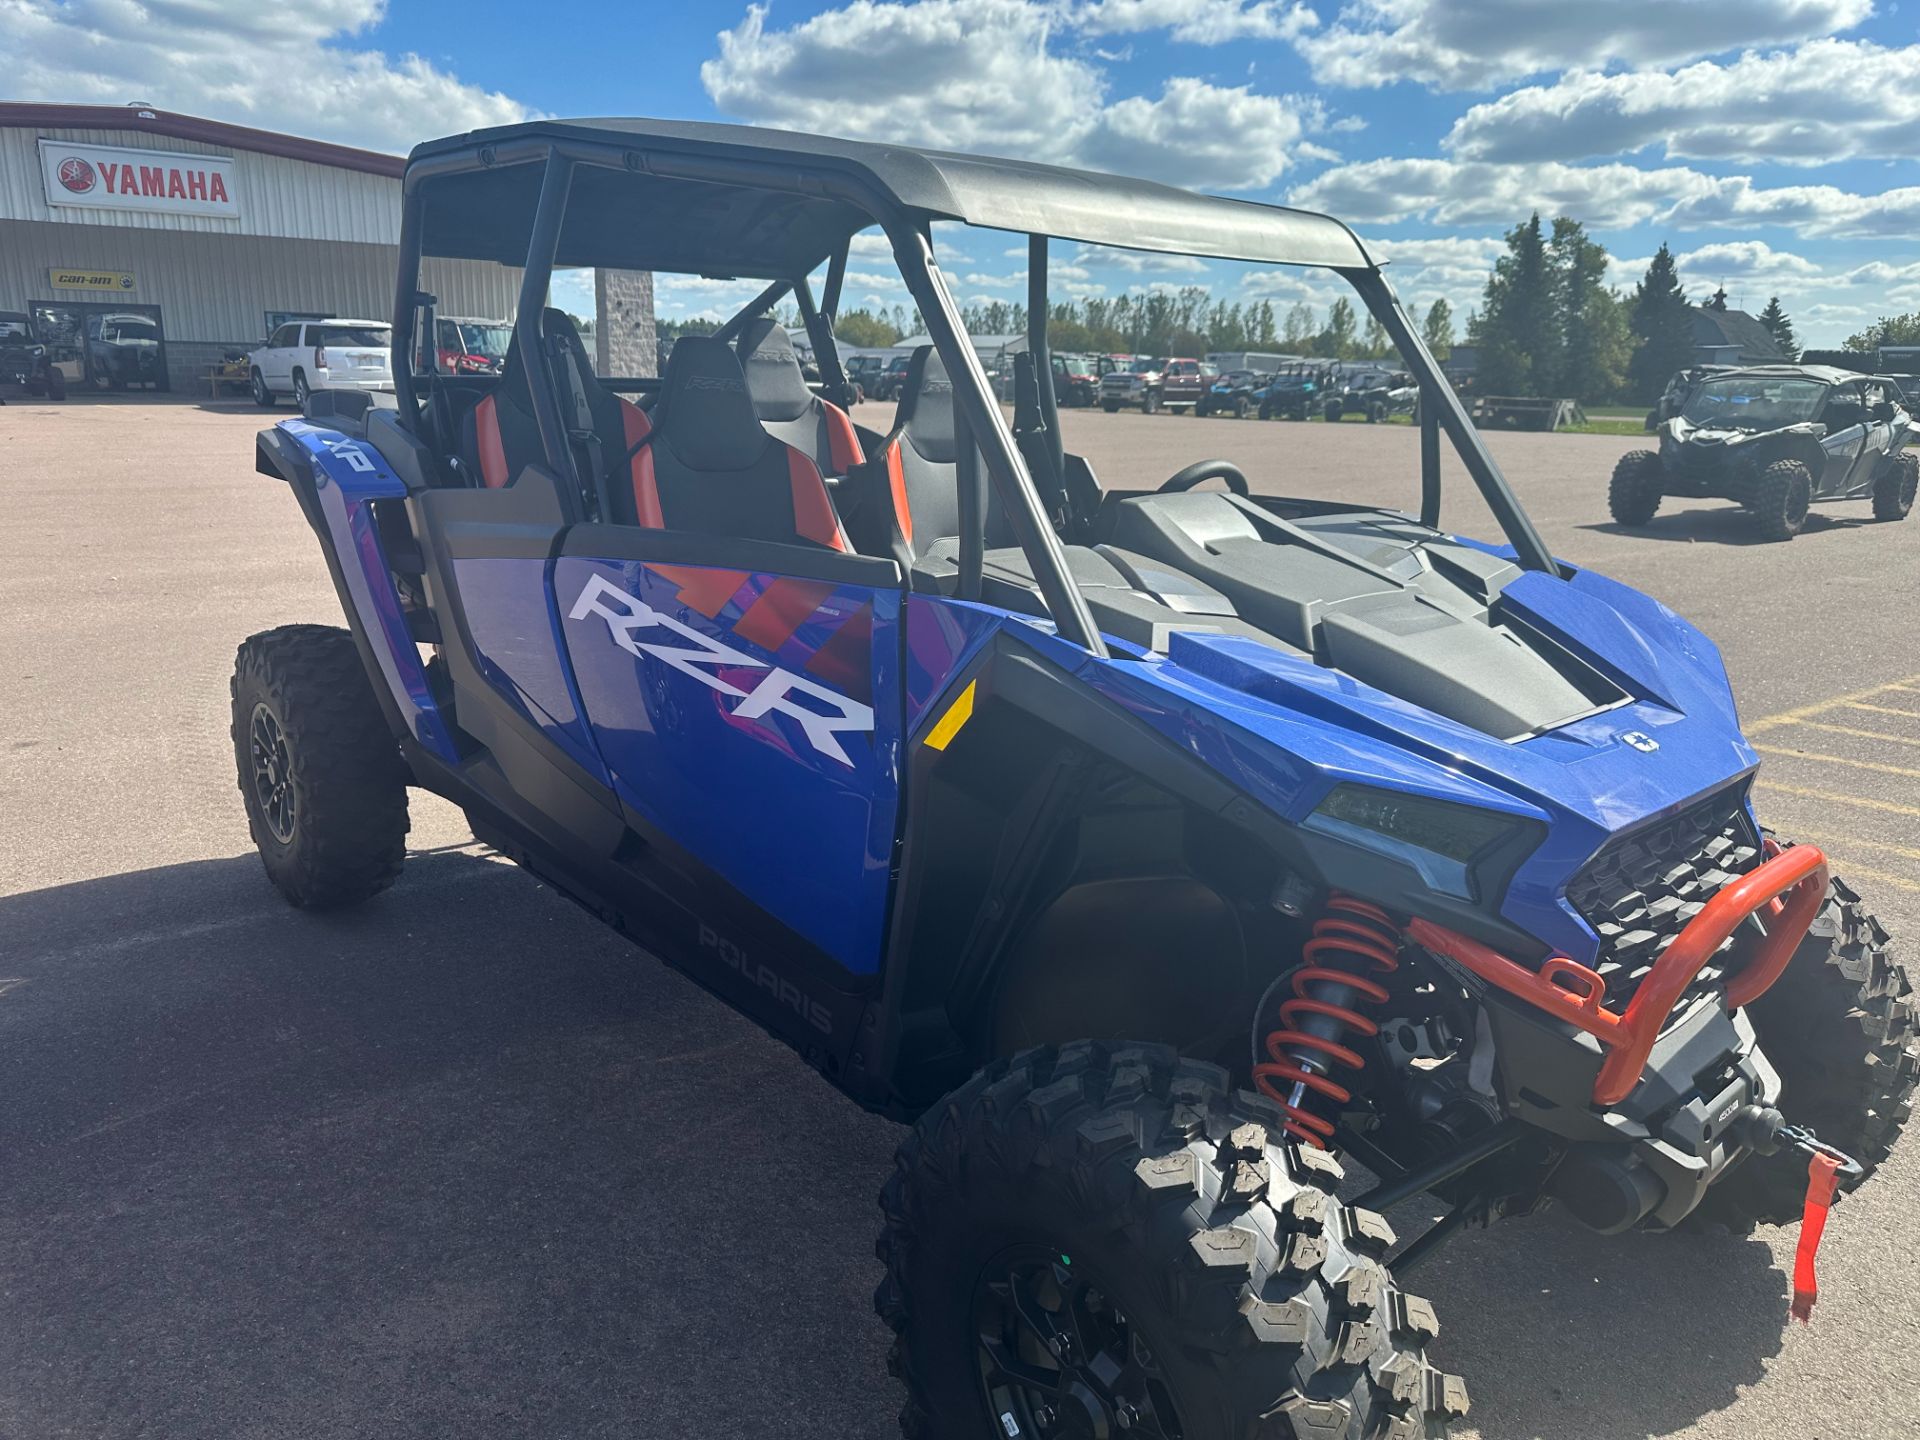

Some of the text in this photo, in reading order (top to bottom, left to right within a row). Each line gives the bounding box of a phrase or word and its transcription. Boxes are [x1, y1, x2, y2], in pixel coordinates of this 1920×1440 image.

[97, 161, 229, 203] YAMAHA
[58, 274, 113, 285] can-am
[322, 438, 377, 473] XP
[569, 573, 875, 769] RZR
[699, 923, 833, 1035] POLARIS
